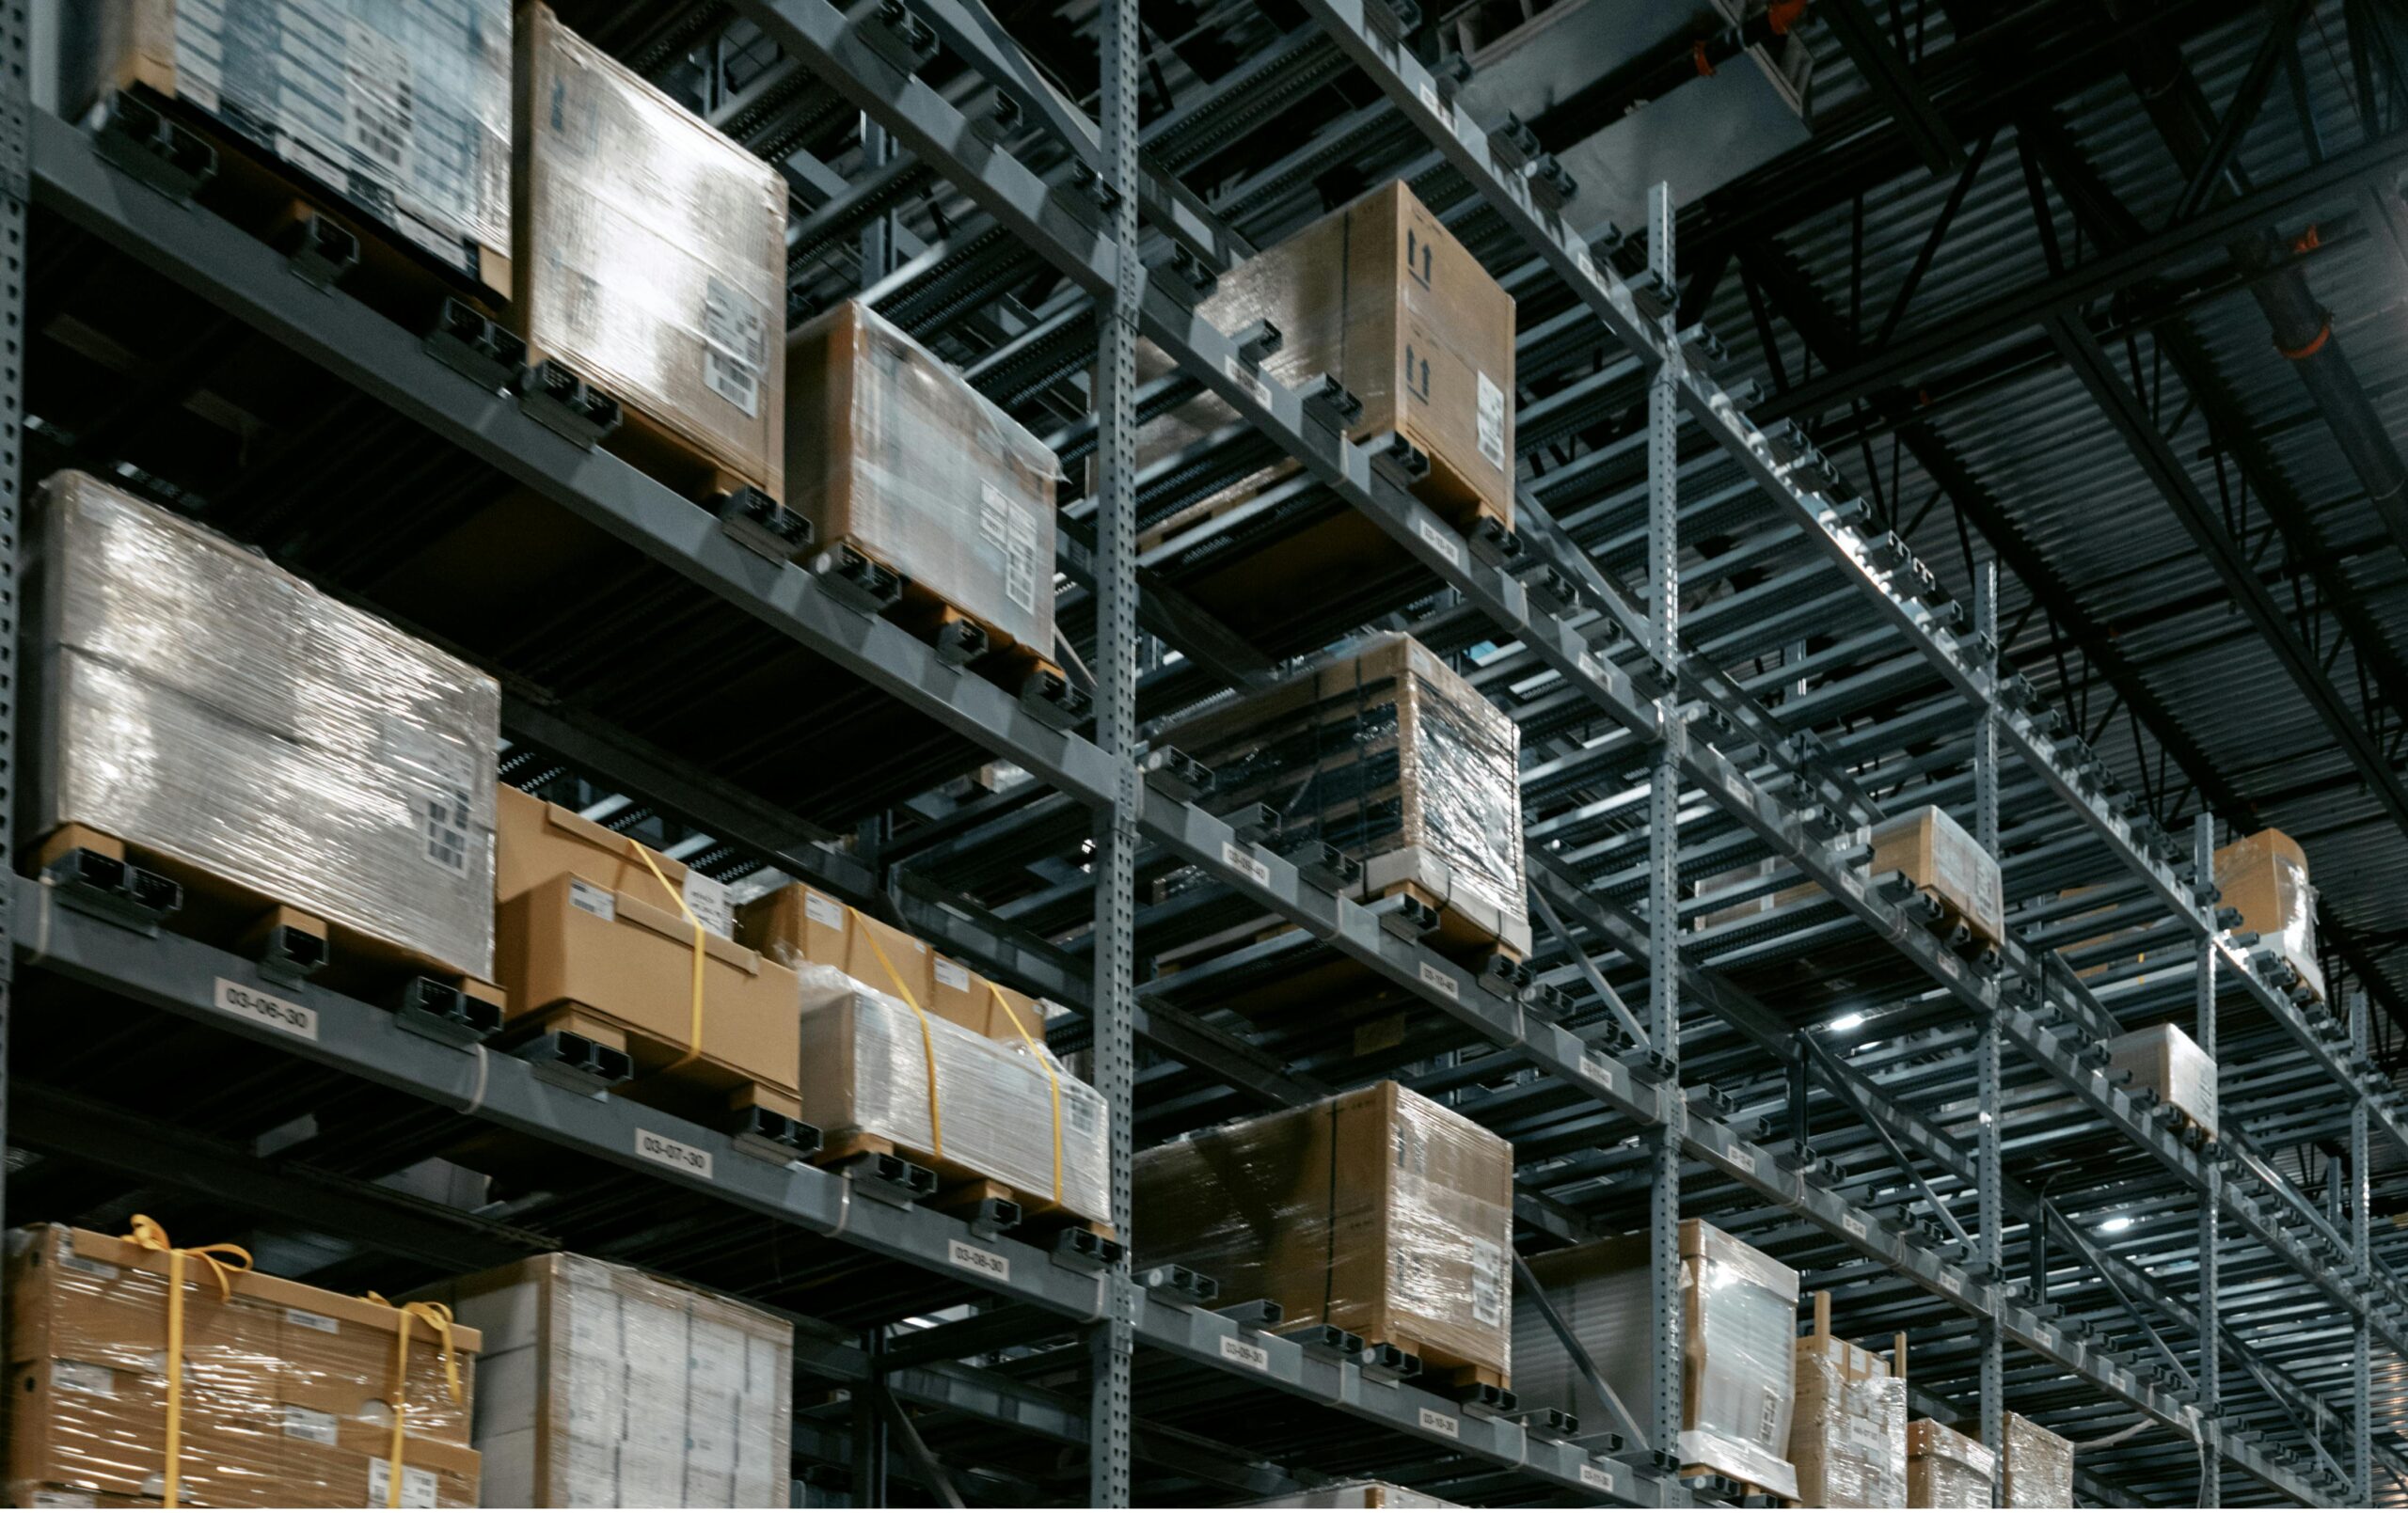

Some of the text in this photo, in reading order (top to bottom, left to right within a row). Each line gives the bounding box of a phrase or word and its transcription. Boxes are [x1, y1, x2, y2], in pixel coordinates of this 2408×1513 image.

[226, 987, 308, 1030] 03-06-30
[643, 1136, 705, 1170] 03-07-30
[956, 1246, 1004, 1274] 03-08-30
